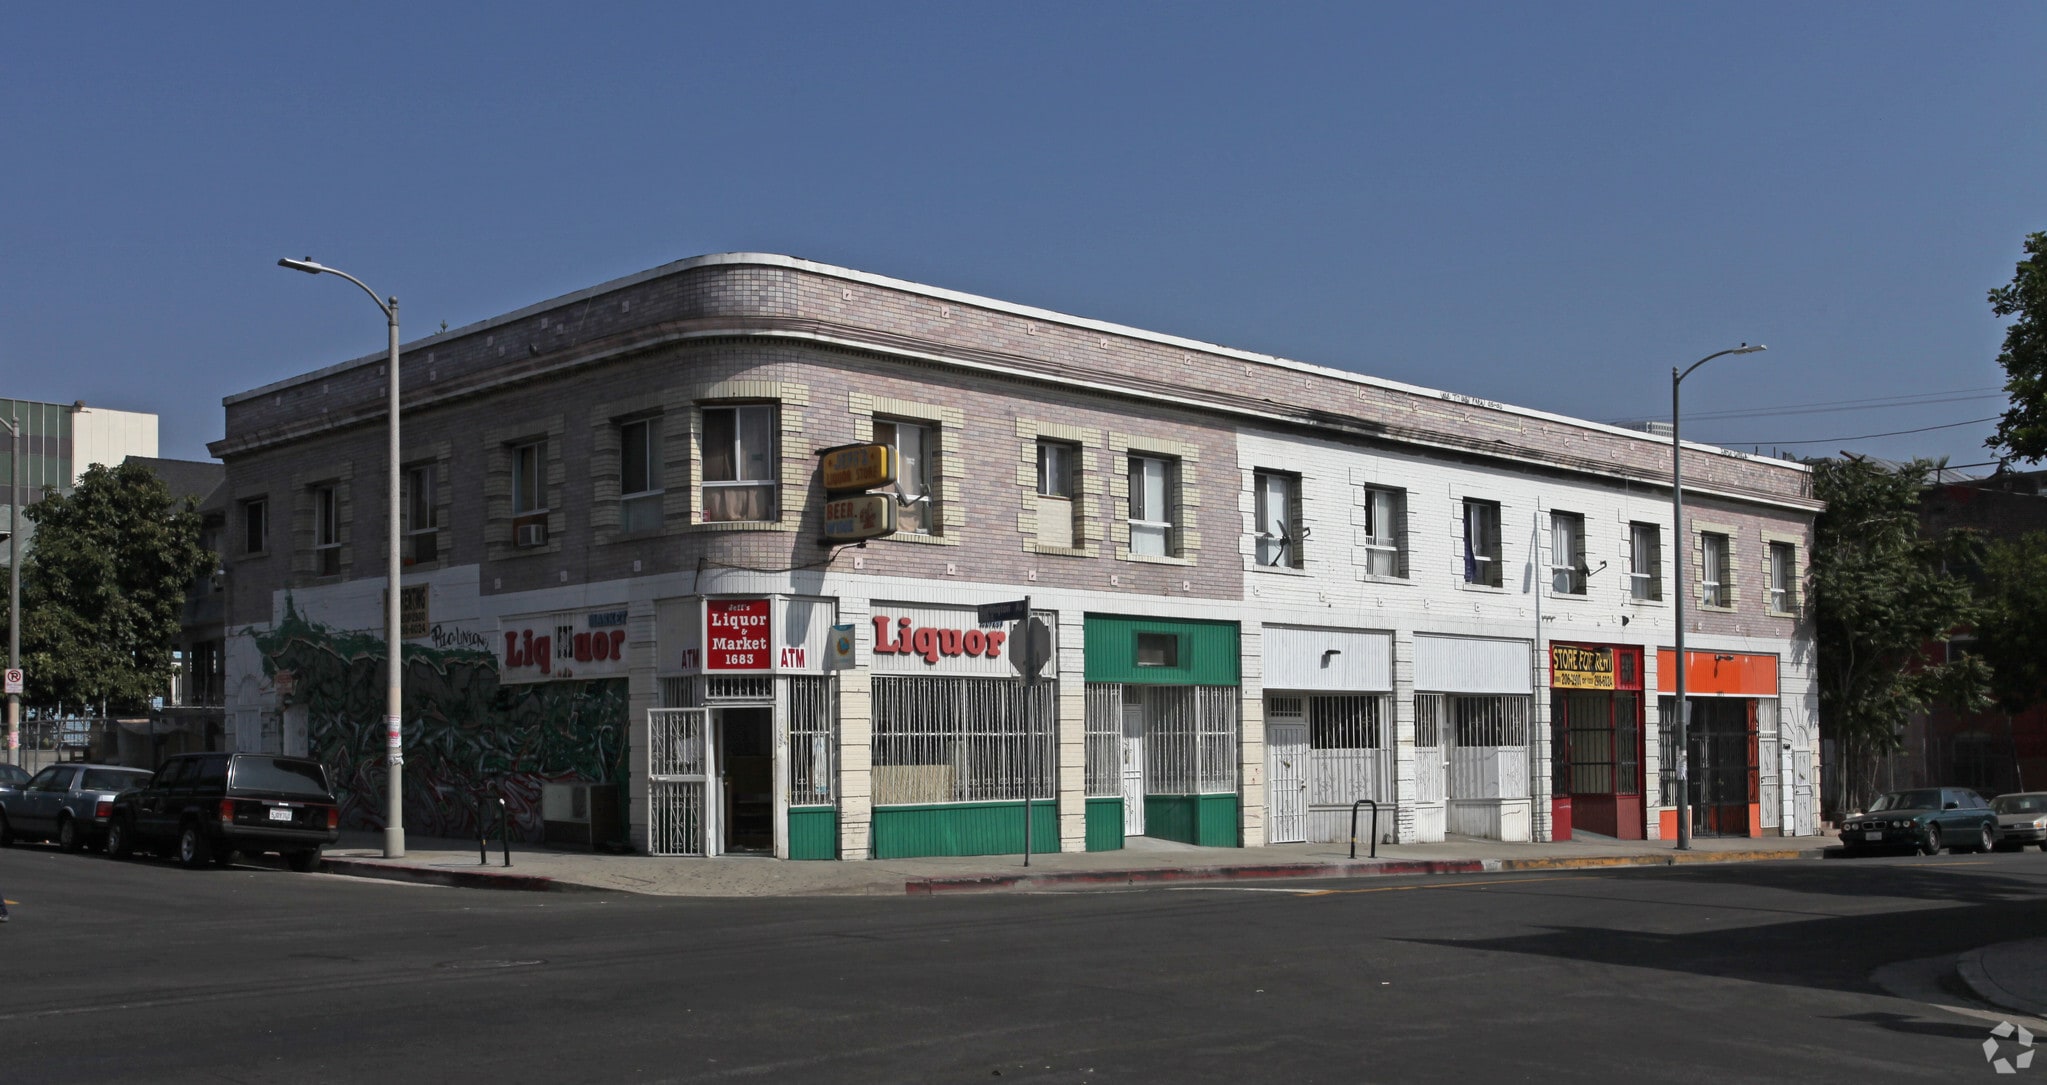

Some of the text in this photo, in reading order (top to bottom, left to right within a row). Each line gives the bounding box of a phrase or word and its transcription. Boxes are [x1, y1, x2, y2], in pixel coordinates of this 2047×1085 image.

[712, 613, 767, 629] Liquor
[741, 628, 747, 636] &
[873, 615, 1006, 663] Liquor
[712, 637, 767, 650] Market
[682, 648, 699, 669] ATM
[725, 654, 754, 665] 1683
[781, 648, 806, 668] ATM
[1553, 648, 1578, 669] STORE
[1579, 651, 1595, 671] FOR
